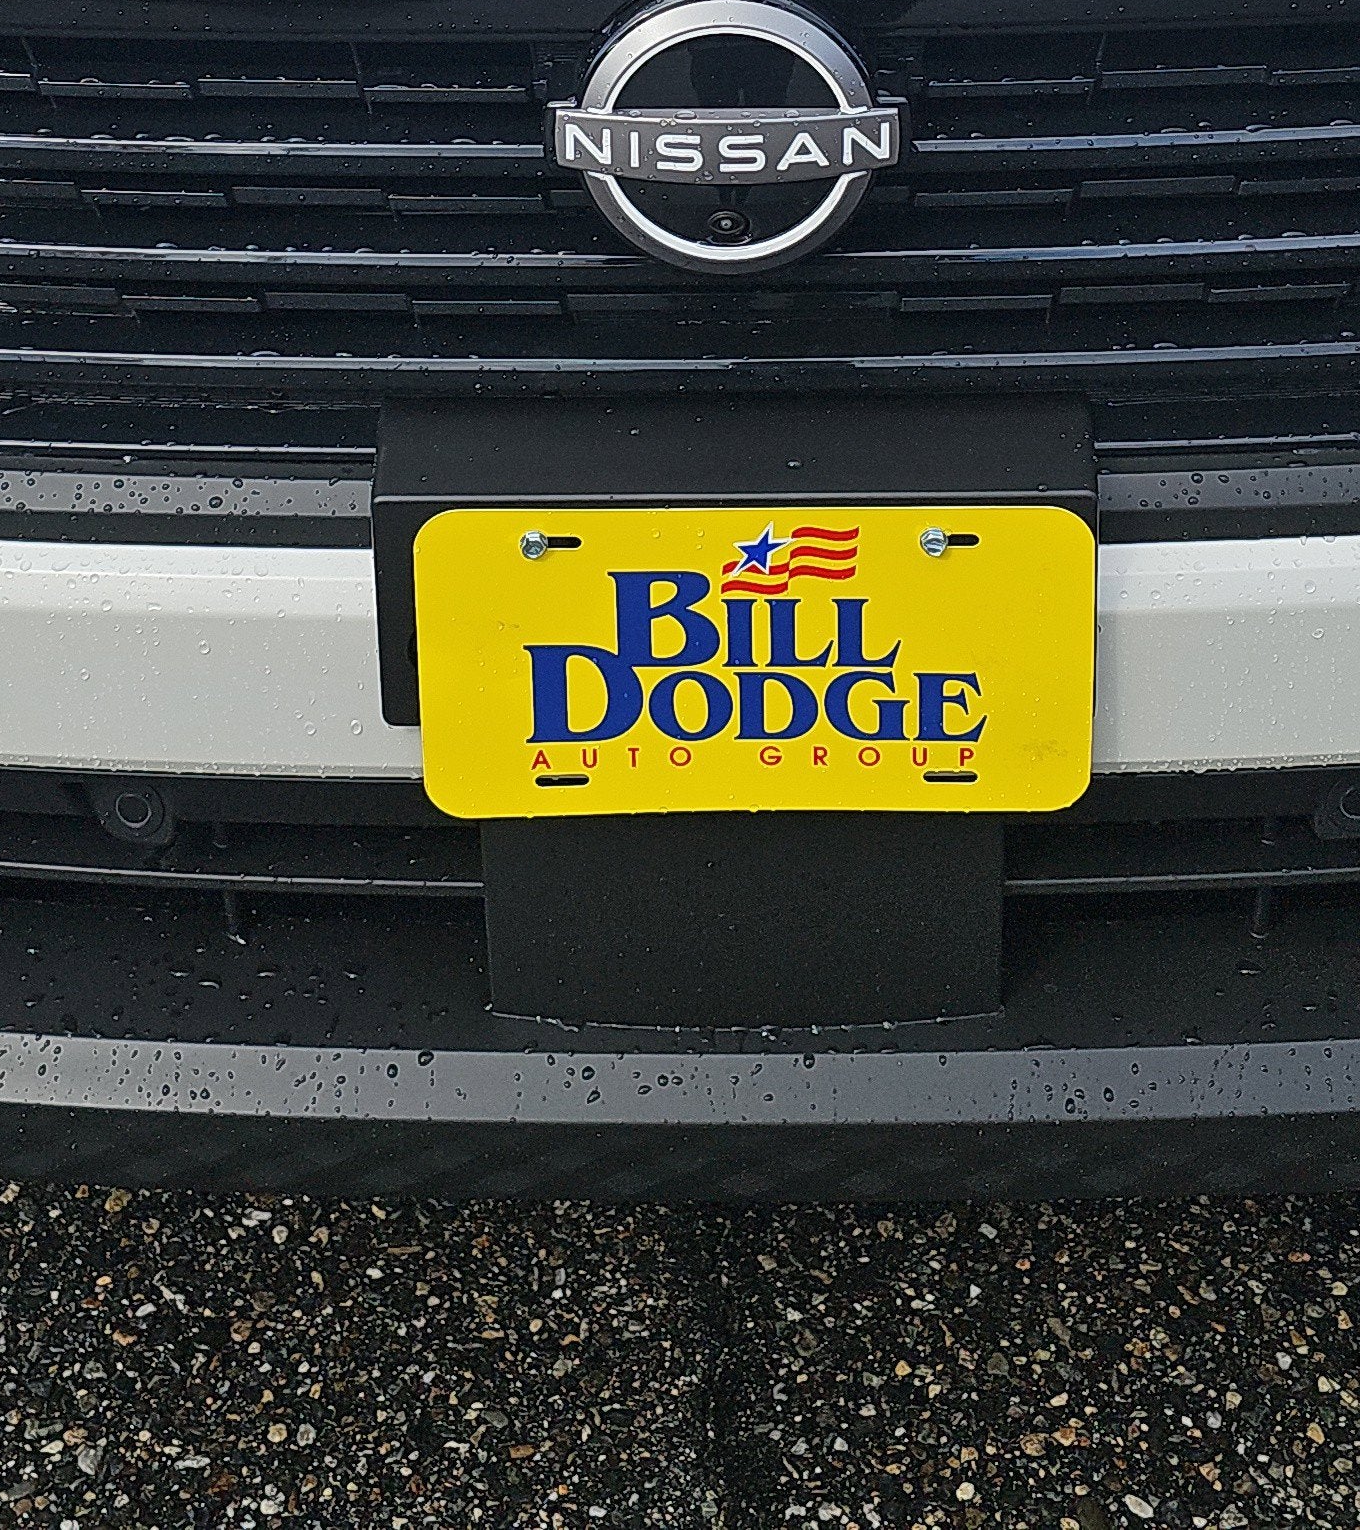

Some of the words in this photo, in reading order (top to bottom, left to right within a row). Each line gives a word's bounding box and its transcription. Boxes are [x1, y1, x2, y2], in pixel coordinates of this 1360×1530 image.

[564, 121, 891, 173] NISSAN
[607, 570, 901, 669] BILL
[523, 644, 988, 744] DODGE
[530, 746, 693, 770] AUTO
[758, 745, 979, 769] GROUP
